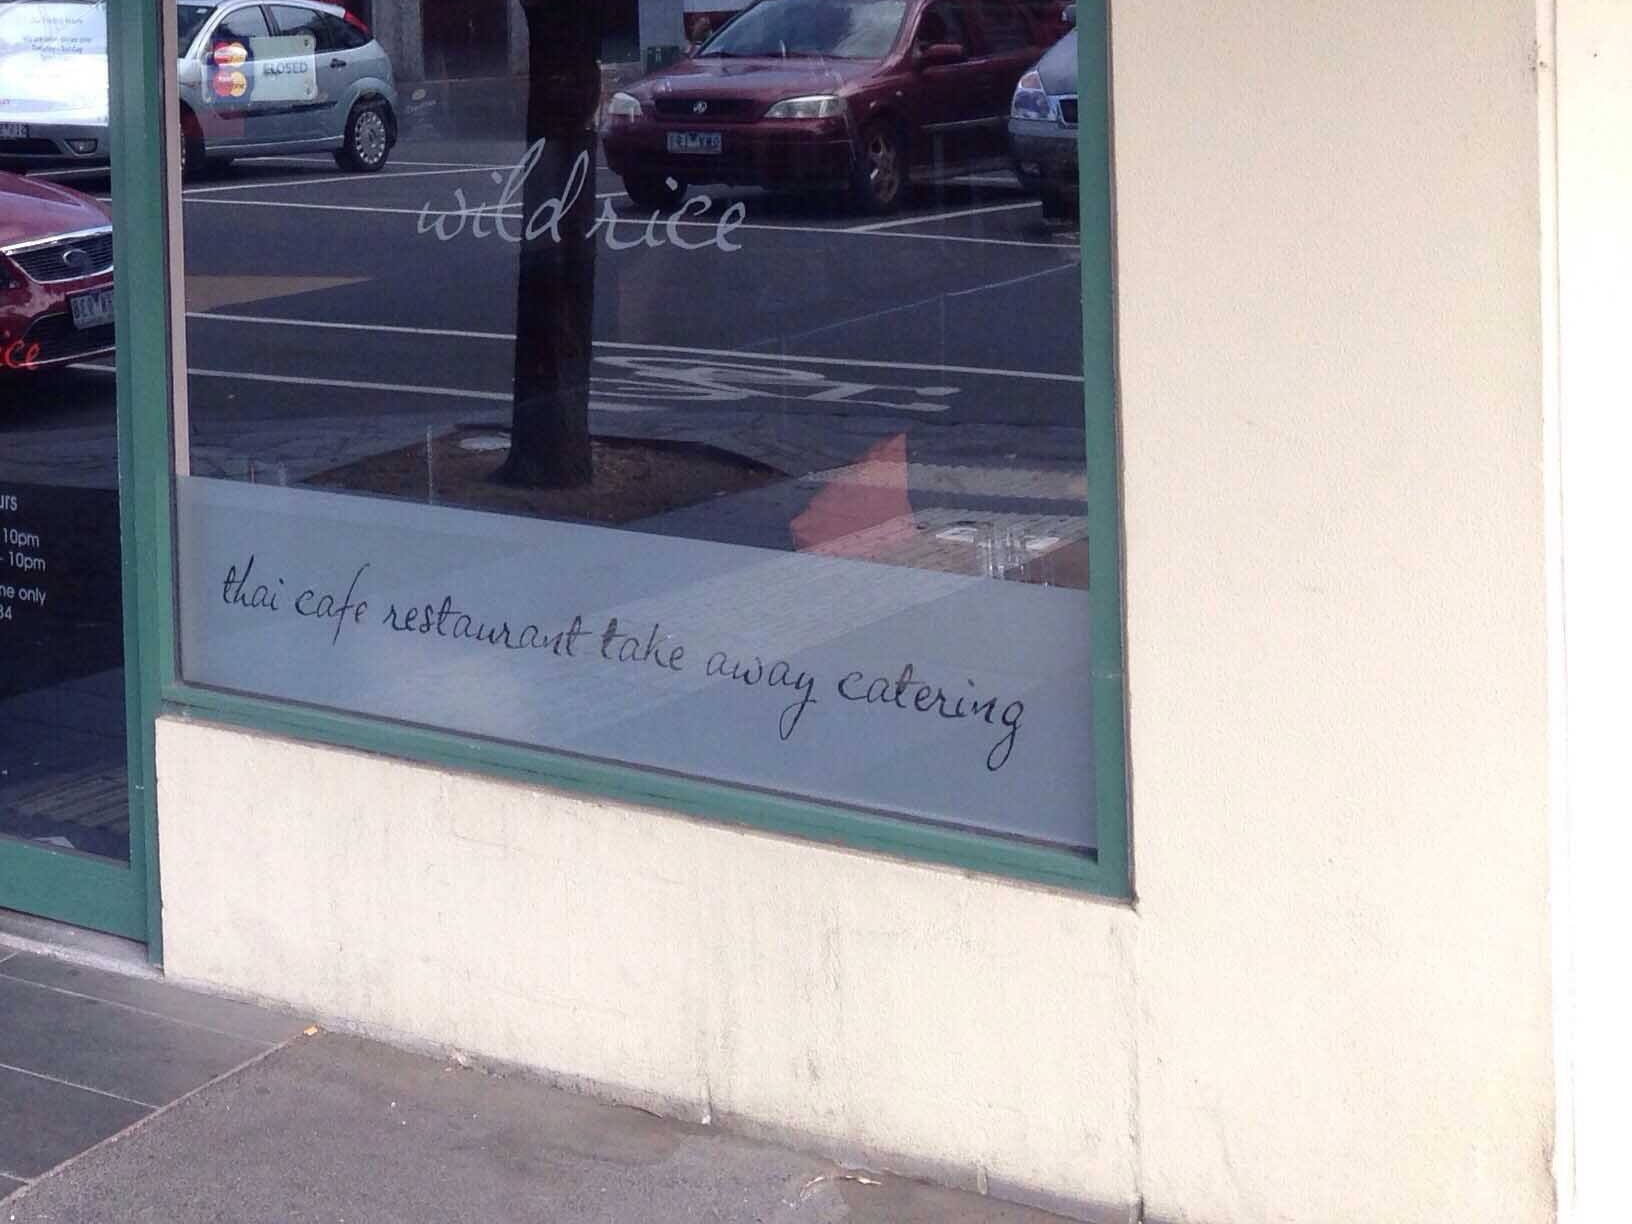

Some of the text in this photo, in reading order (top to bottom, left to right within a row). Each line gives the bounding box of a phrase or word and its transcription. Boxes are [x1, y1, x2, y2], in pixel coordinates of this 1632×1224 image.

[417, 137, 746, 252] wild rice
[3, 527, 40, 548] 10pm
[8, 550, 46, 572] 10pm
[18, 587, 47, 606] only
[222, 554, 1027, 772] thai cafe restaurant take away catering
